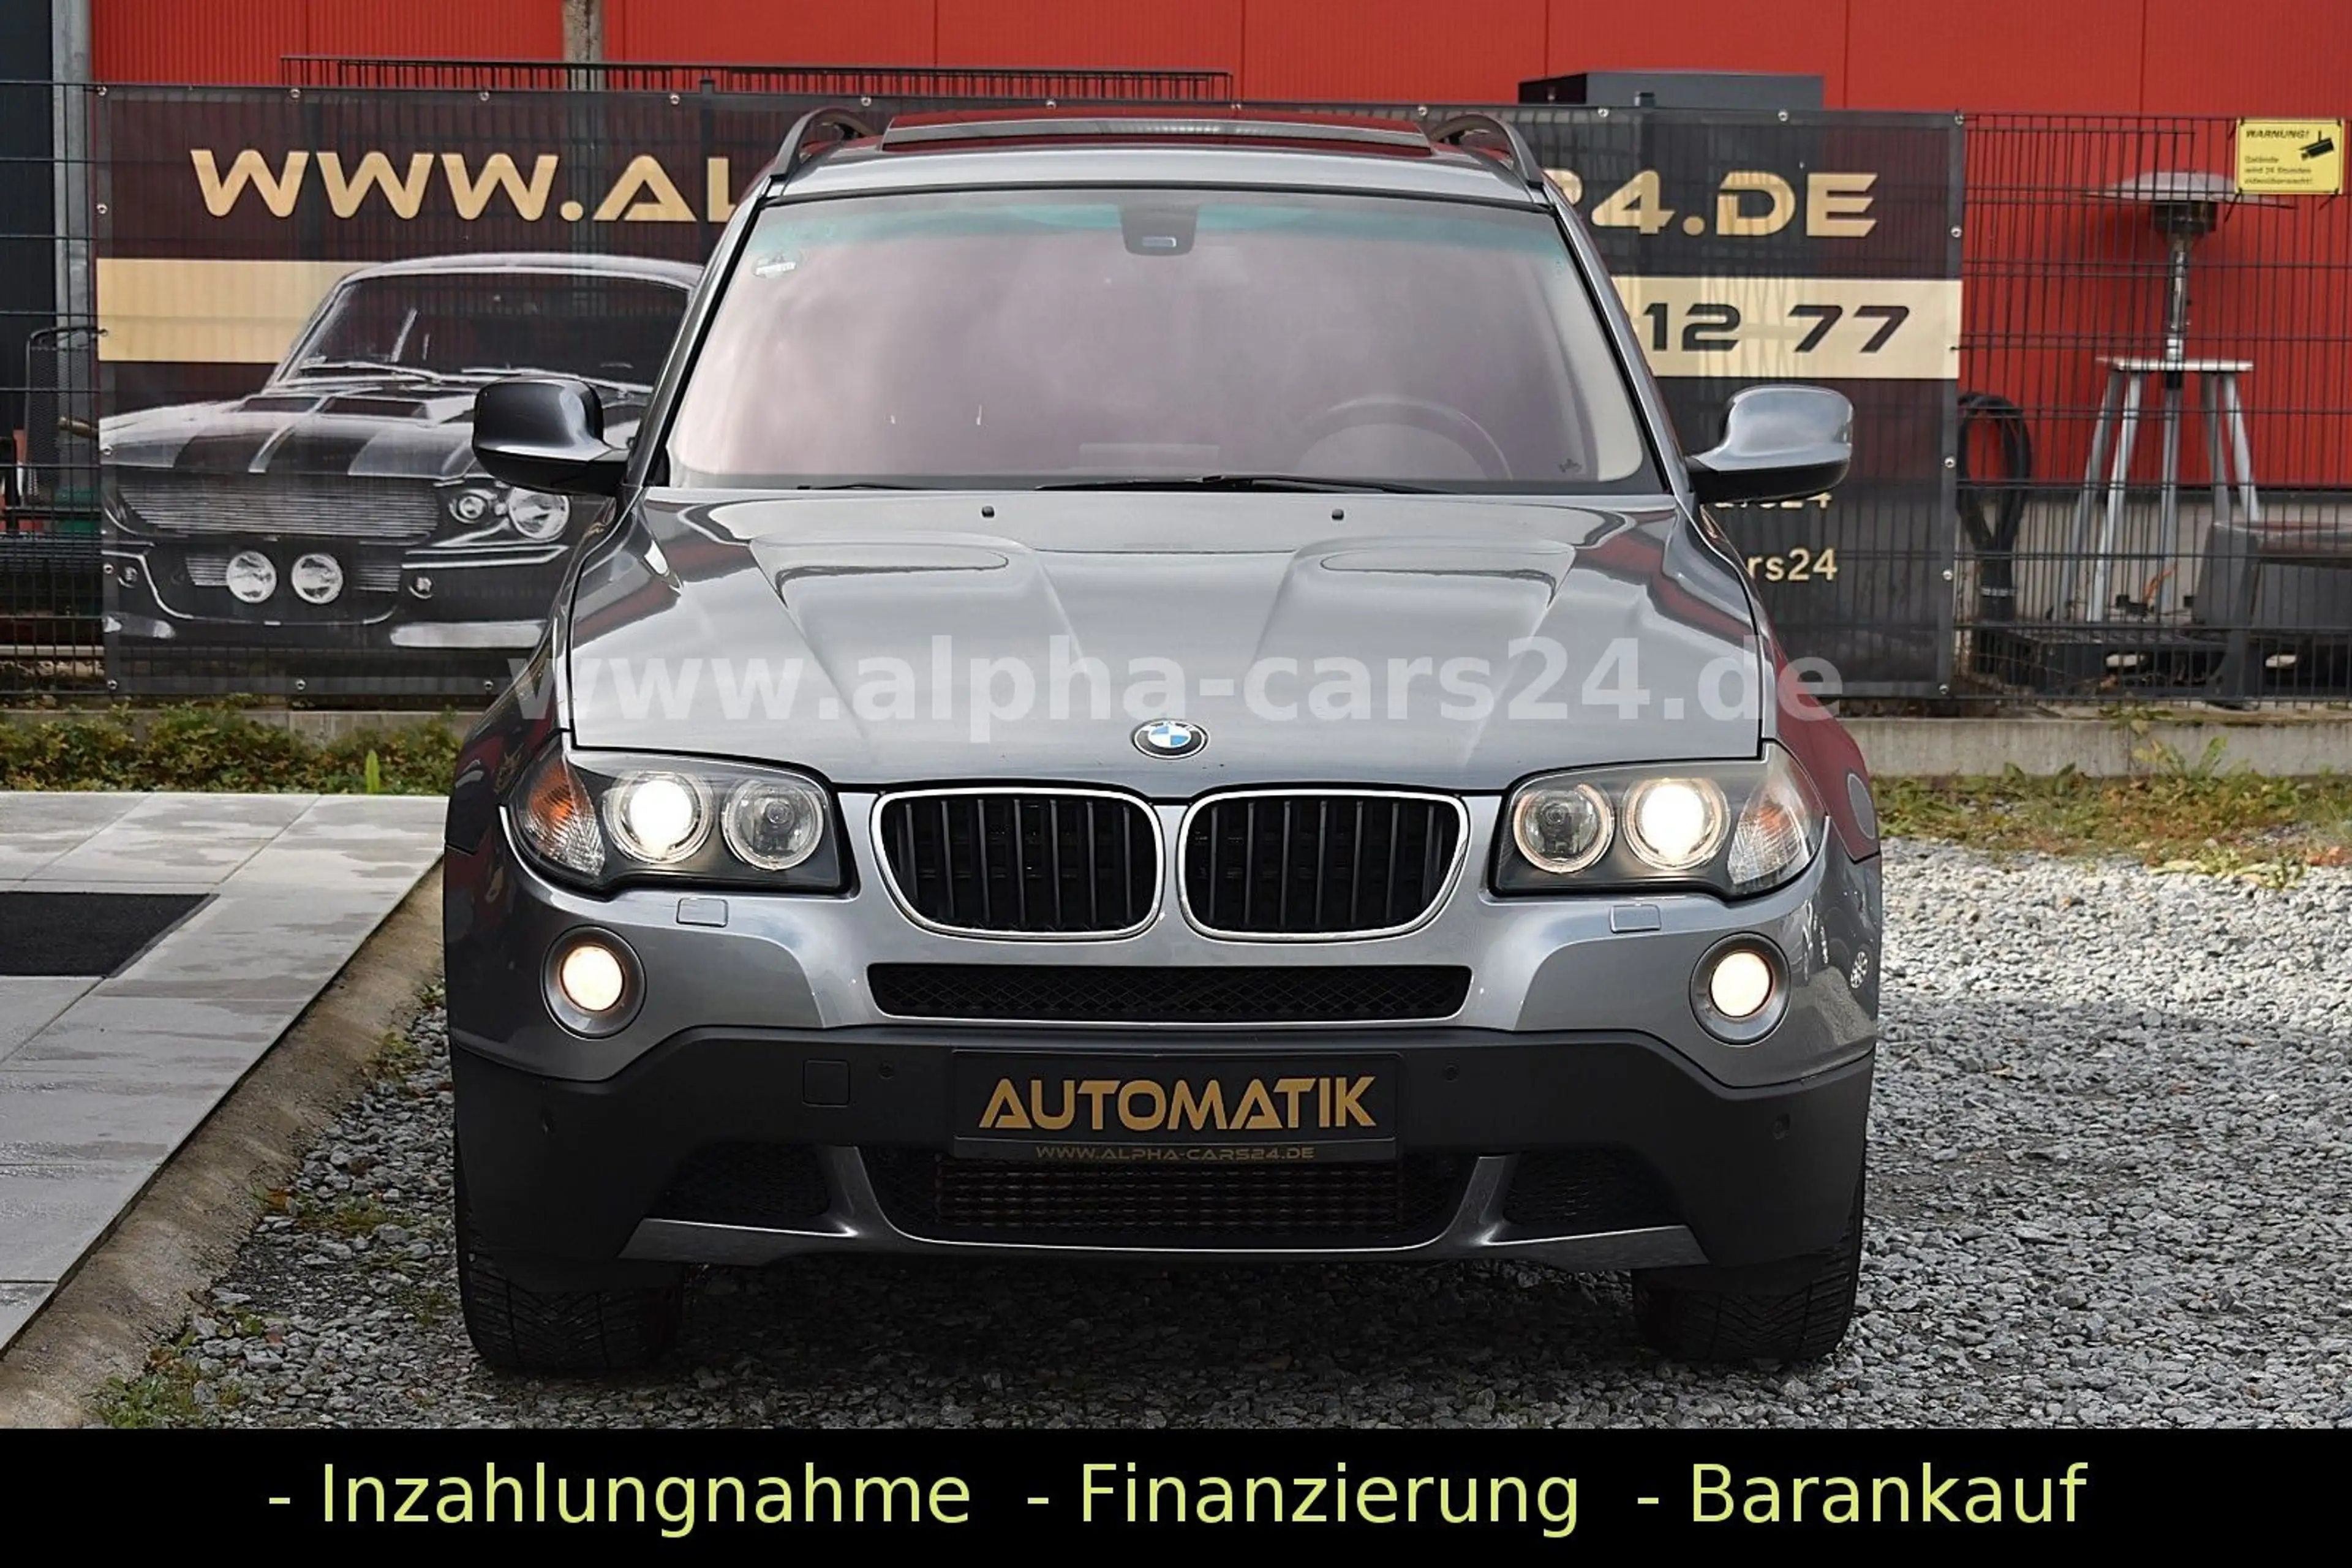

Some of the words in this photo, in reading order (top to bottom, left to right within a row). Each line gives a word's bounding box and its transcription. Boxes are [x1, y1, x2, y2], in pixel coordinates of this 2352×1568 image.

[2246, 129, 2310, 138] WARNUNG!
[1643, 303, 1741, 352] 12
[1787, 304, 1910, 353] 77
[979, 1076, 1378, 1131] AUTOMATIK
[1035, 1145, 1316, 1161] WWW.ALPHA-CARS24.DE
